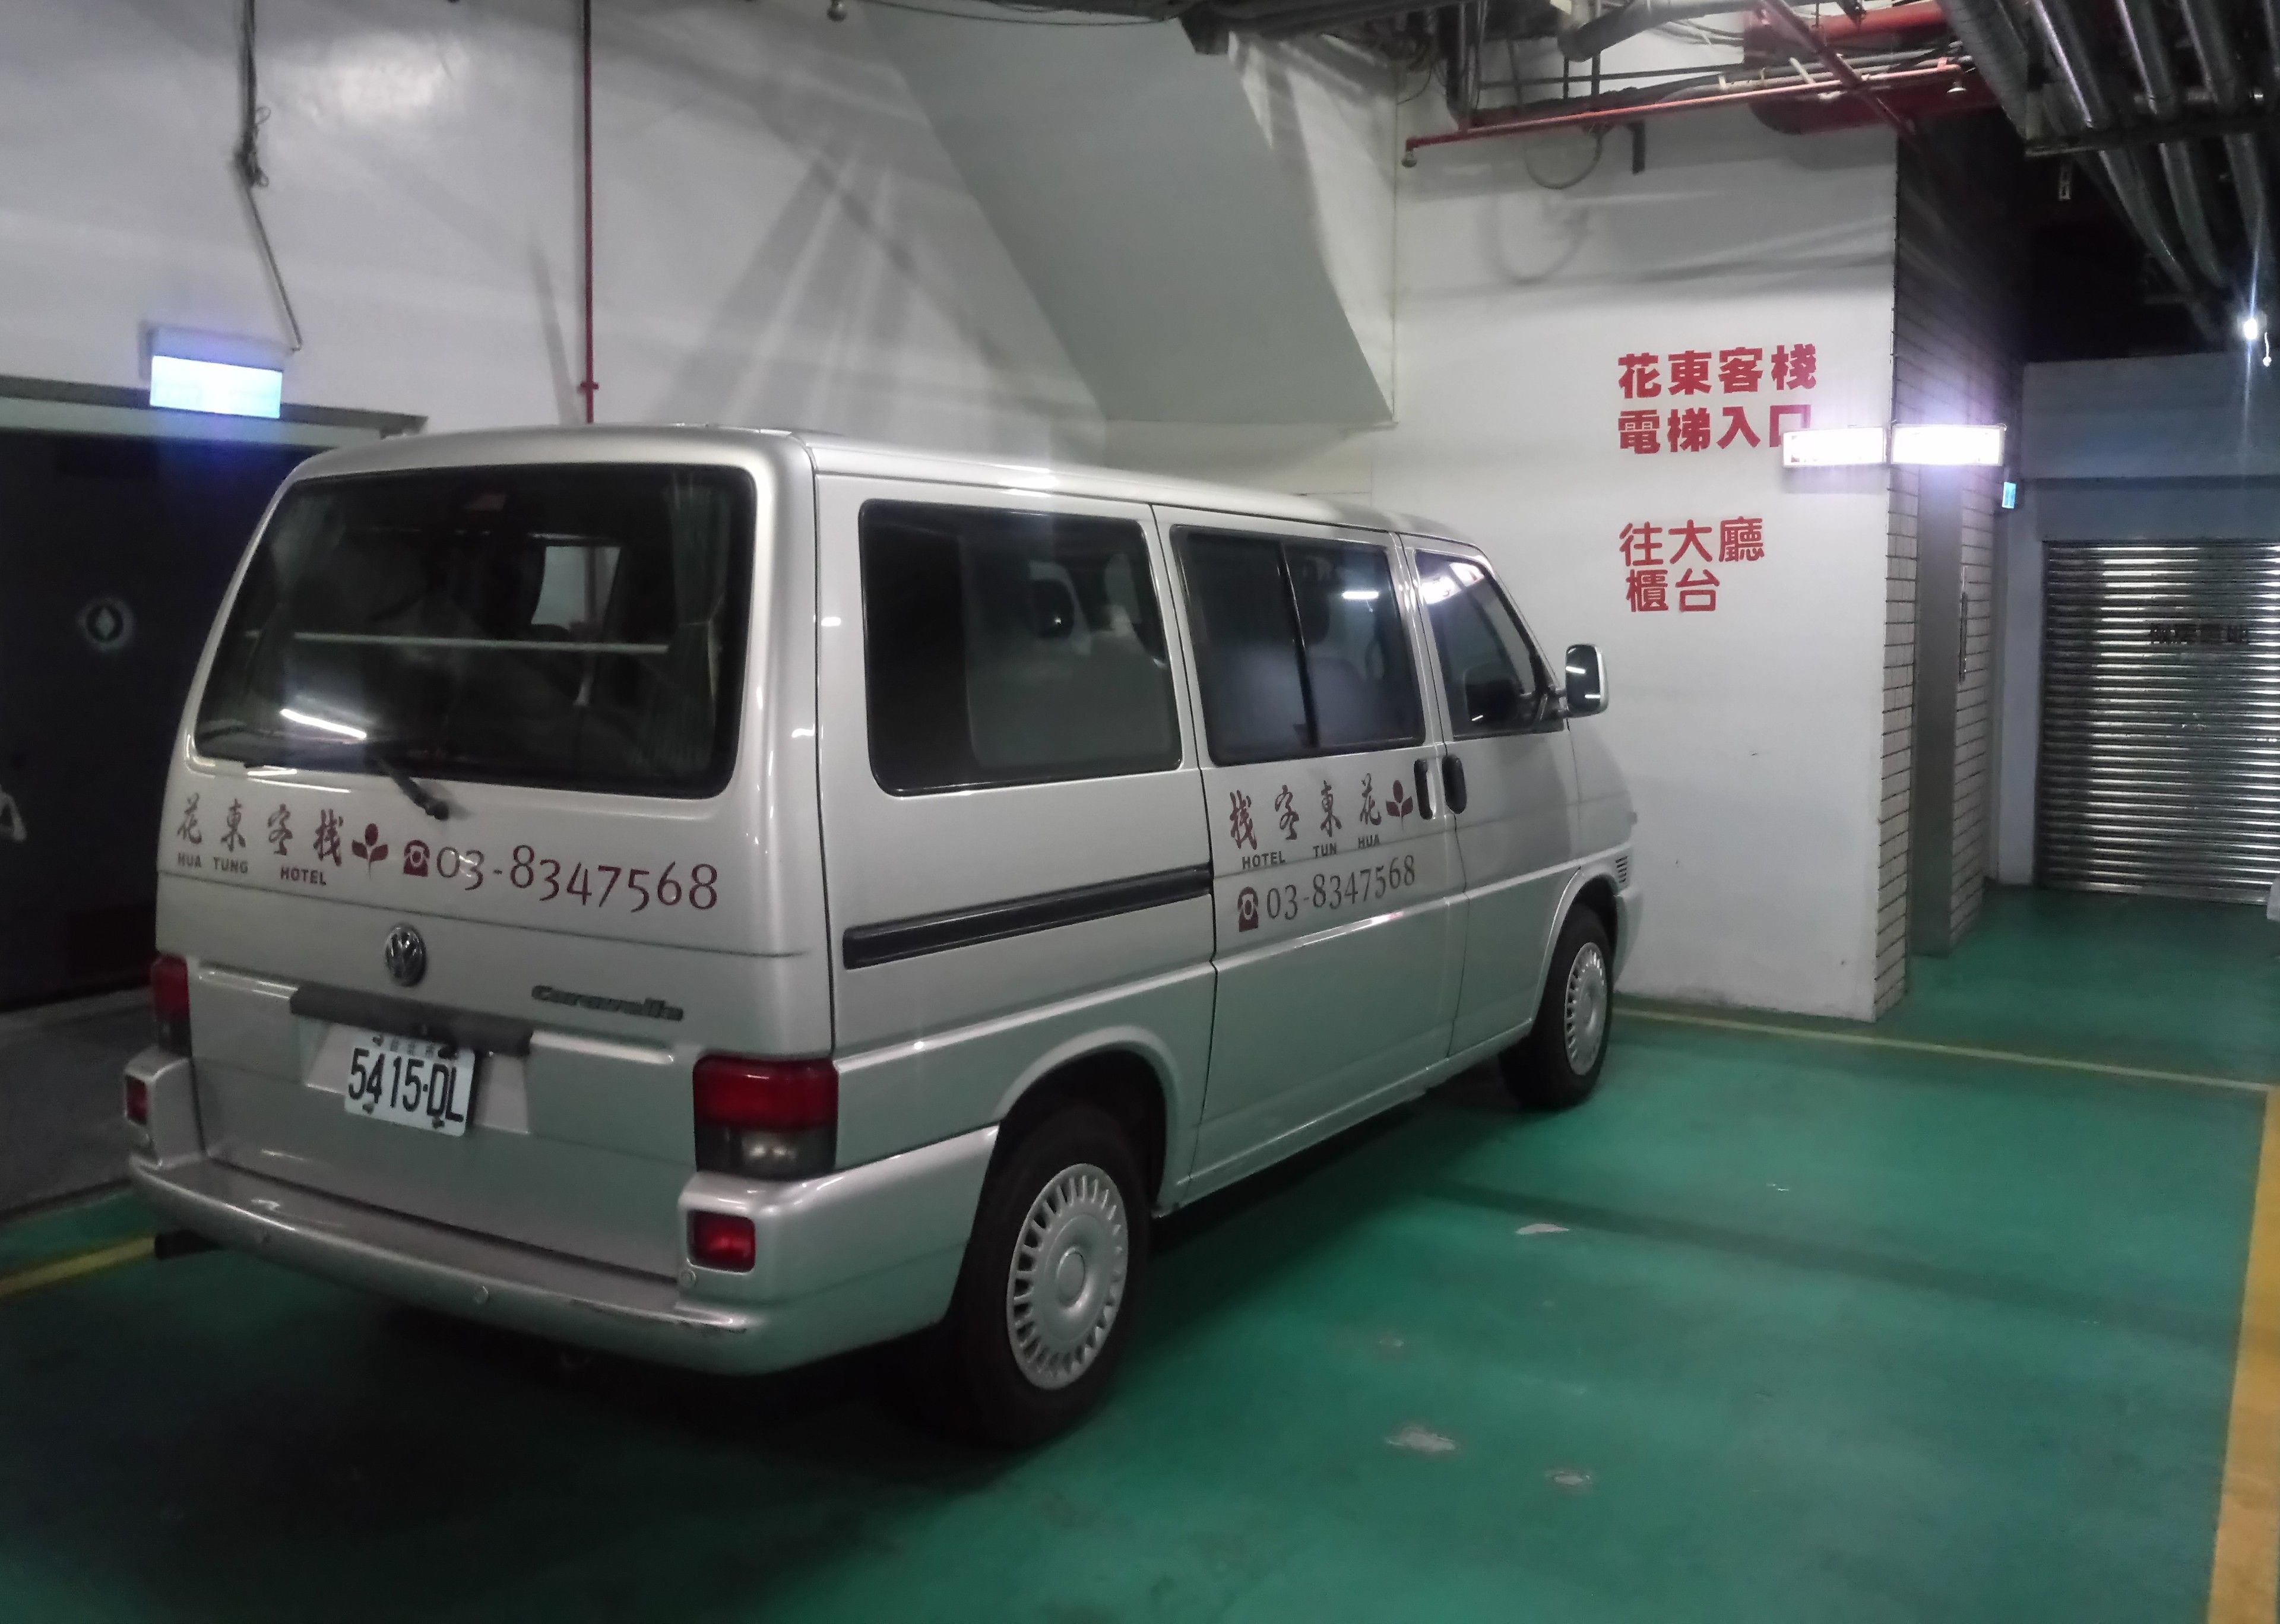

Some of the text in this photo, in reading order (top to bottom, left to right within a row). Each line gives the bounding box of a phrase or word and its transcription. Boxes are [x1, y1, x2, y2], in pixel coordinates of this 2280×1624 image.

[1618, 343, 1817, 399] 花東客棧
[1618, 404, 1812, 454] 電梯入口
[1619, 516, 1765, 566] 往大廳
[1625, 568, 1720, 613] 櫃台
[178, 853, 327, 886] HUA TUNG HOTEL
[1242, 850, 1286, 870] HOTEL
[1358, 834, 1380, 849] HUA
[436, 844, 718, 913] 03-8347568
[1266, 854, 1415, 920] 03-8347568
